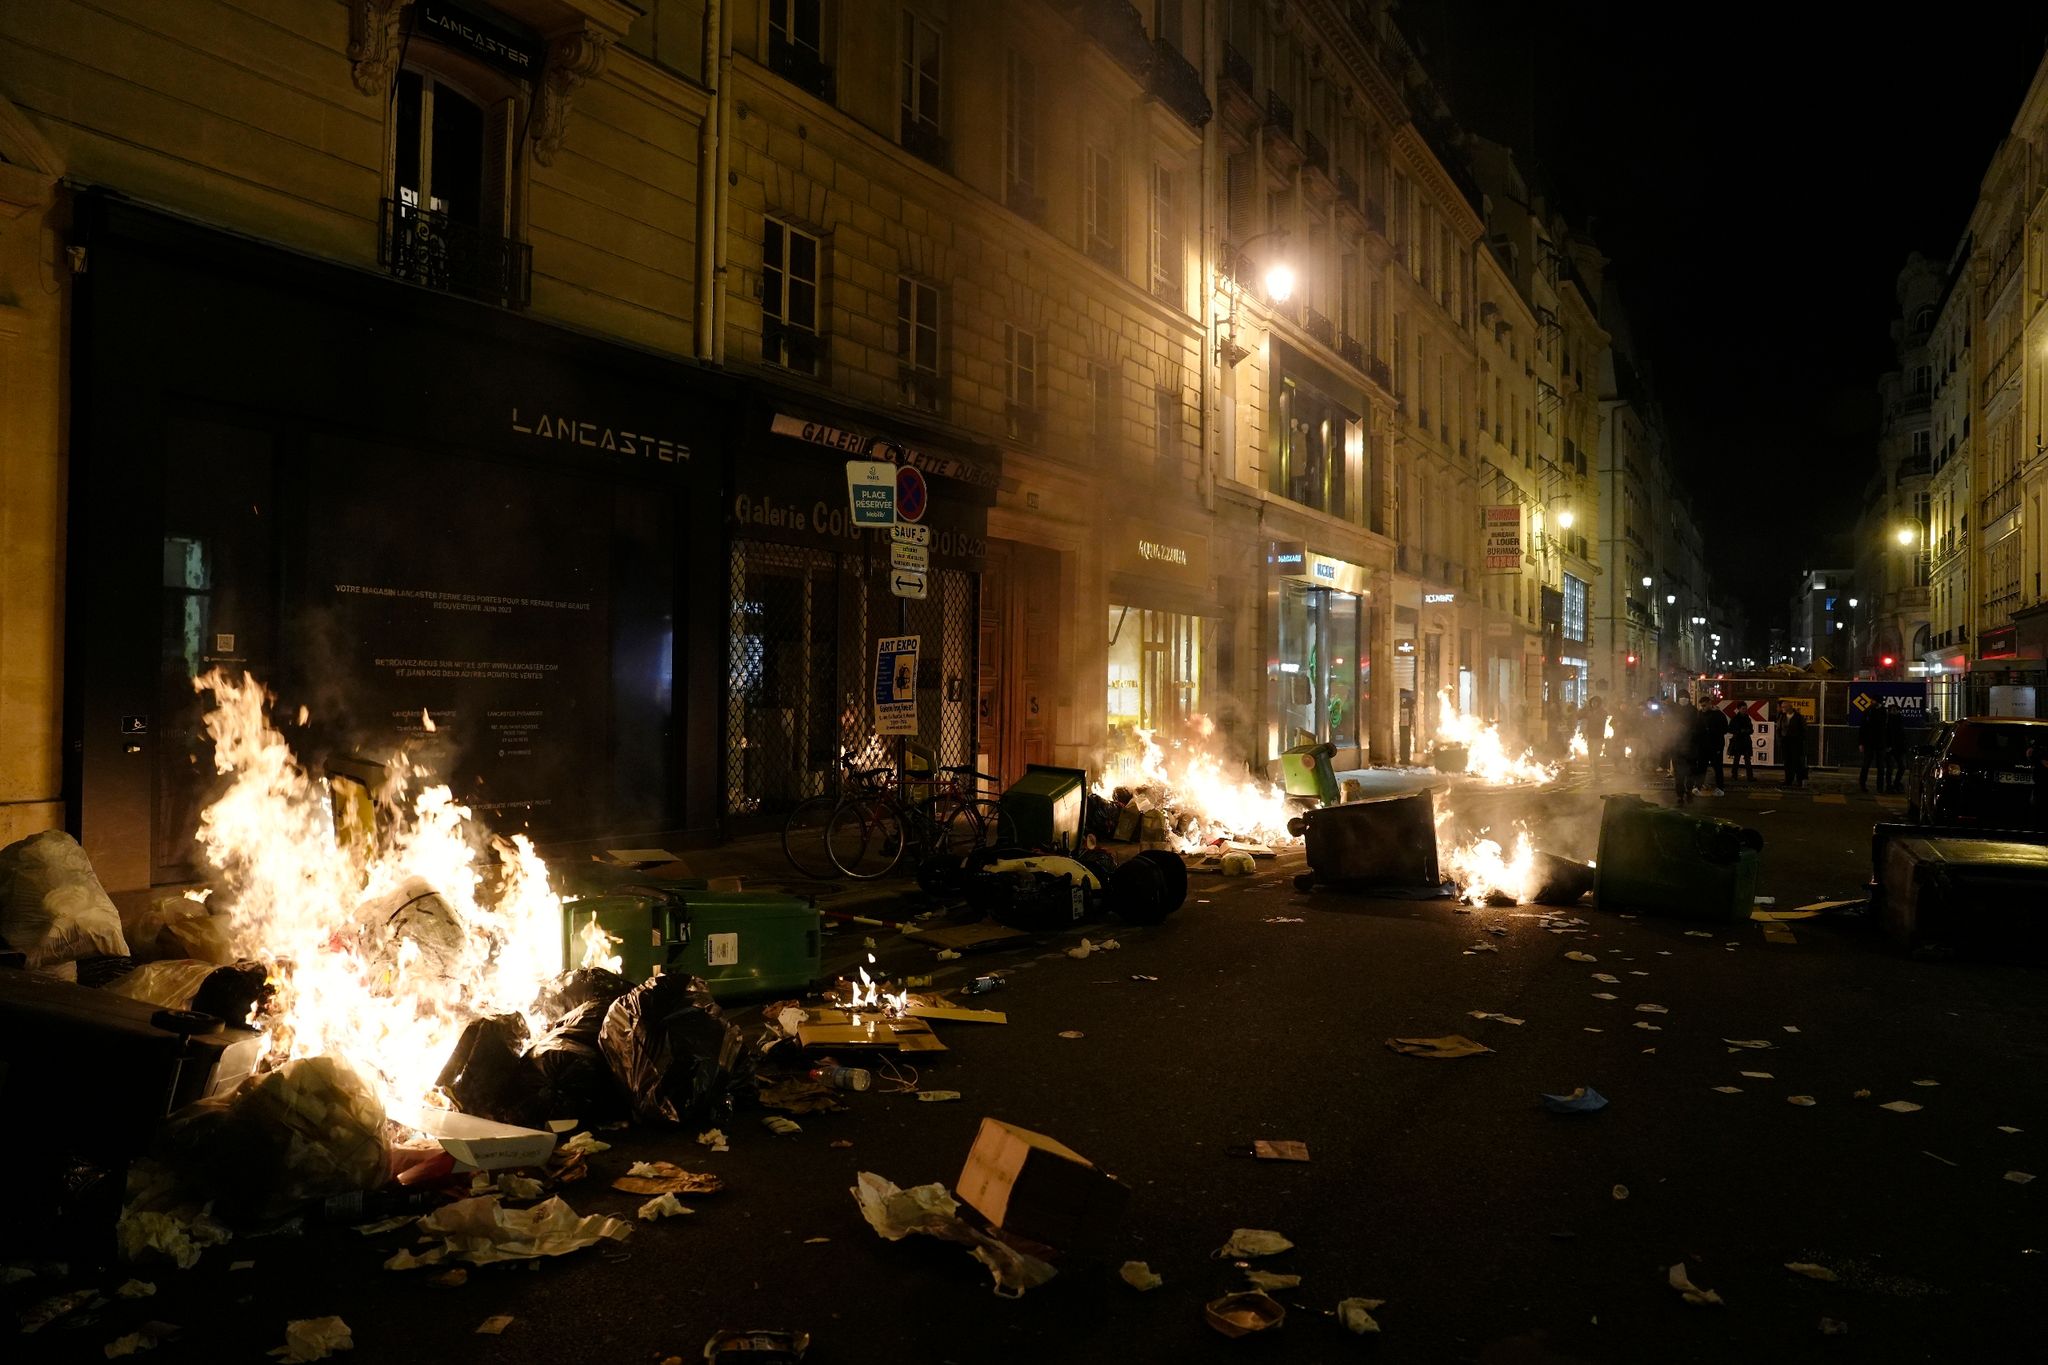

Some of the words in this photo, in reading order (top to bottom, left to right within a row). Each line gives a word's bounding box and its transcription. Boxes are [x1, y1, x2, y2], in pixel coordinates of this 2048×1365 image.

[426, 8, 529, 67] LANCASTER
[512, 407, 691, 463] LANCASTER
[884, 449, 950, 475] CLETTE
[861, 490, 886, 499] PLACE
[855, 498, 893, 509] RÉSERVÉE
[734, 494, 806, 530] Galerie
[895, 525, 917, 538] SAUF
[1496, 537, 1520, 546] LOUER
[335, 584, 361, 593] VOTRE
[362, 586, 396, 597] MAGASIN
[396, 589, 437, 599] LANCASTER
[438, 592, 462, 601] FERME
[477, 595, 501, 604] PORTES
[502, 597, 520, 605] POUR
[484, 604, 497, 612] JUIN
[880, 641, 895, 652] ART
[896, 639, 918, 650] EXPO
